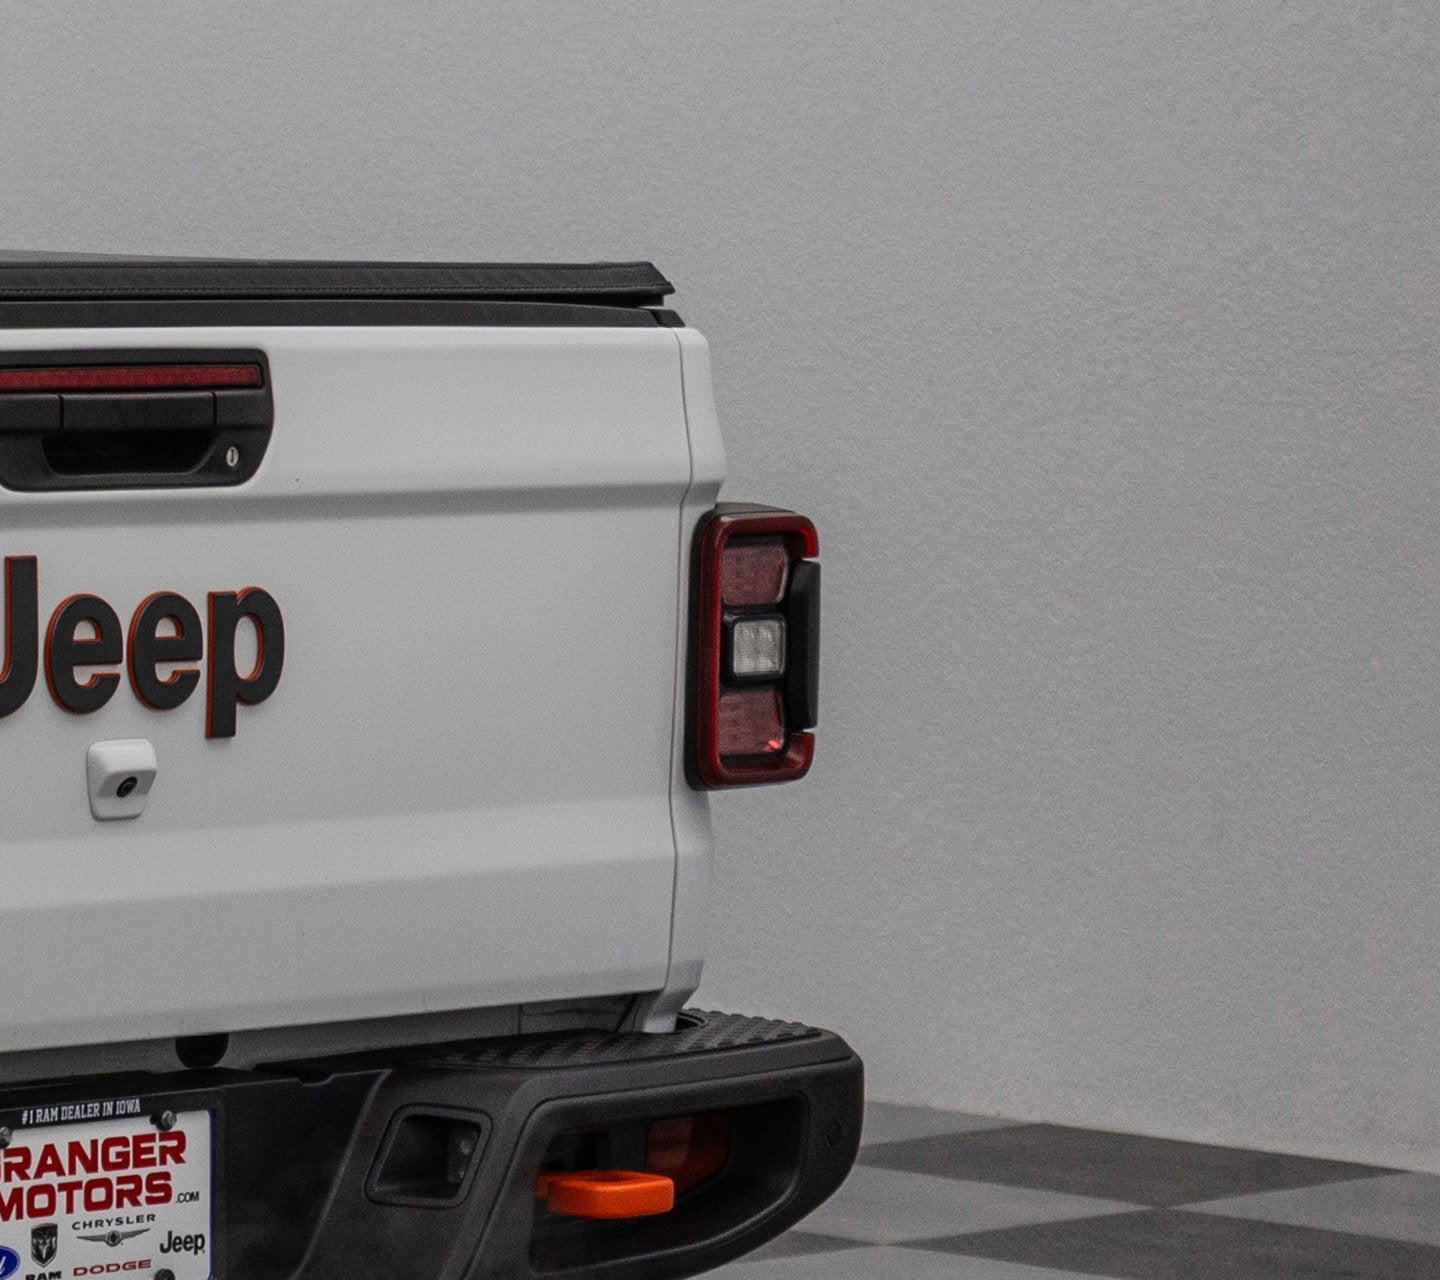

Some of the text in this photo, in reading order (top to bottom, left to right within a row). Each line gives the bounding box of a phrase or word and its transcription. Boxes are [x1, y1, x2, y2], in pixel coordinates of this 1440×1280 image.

[36, 1106, 59, 1122] RAM
[61, 1102, 100, 1120] DEALER
[102, 1101, 114, 1116] IN
[115, 1098, 141, 1115] IOWA
[71, 1213, 157, 1231] CHRYSLER
[159, 1230, 206, 1256] Jeep
[72, 1259, 152, 1277] DODGE
